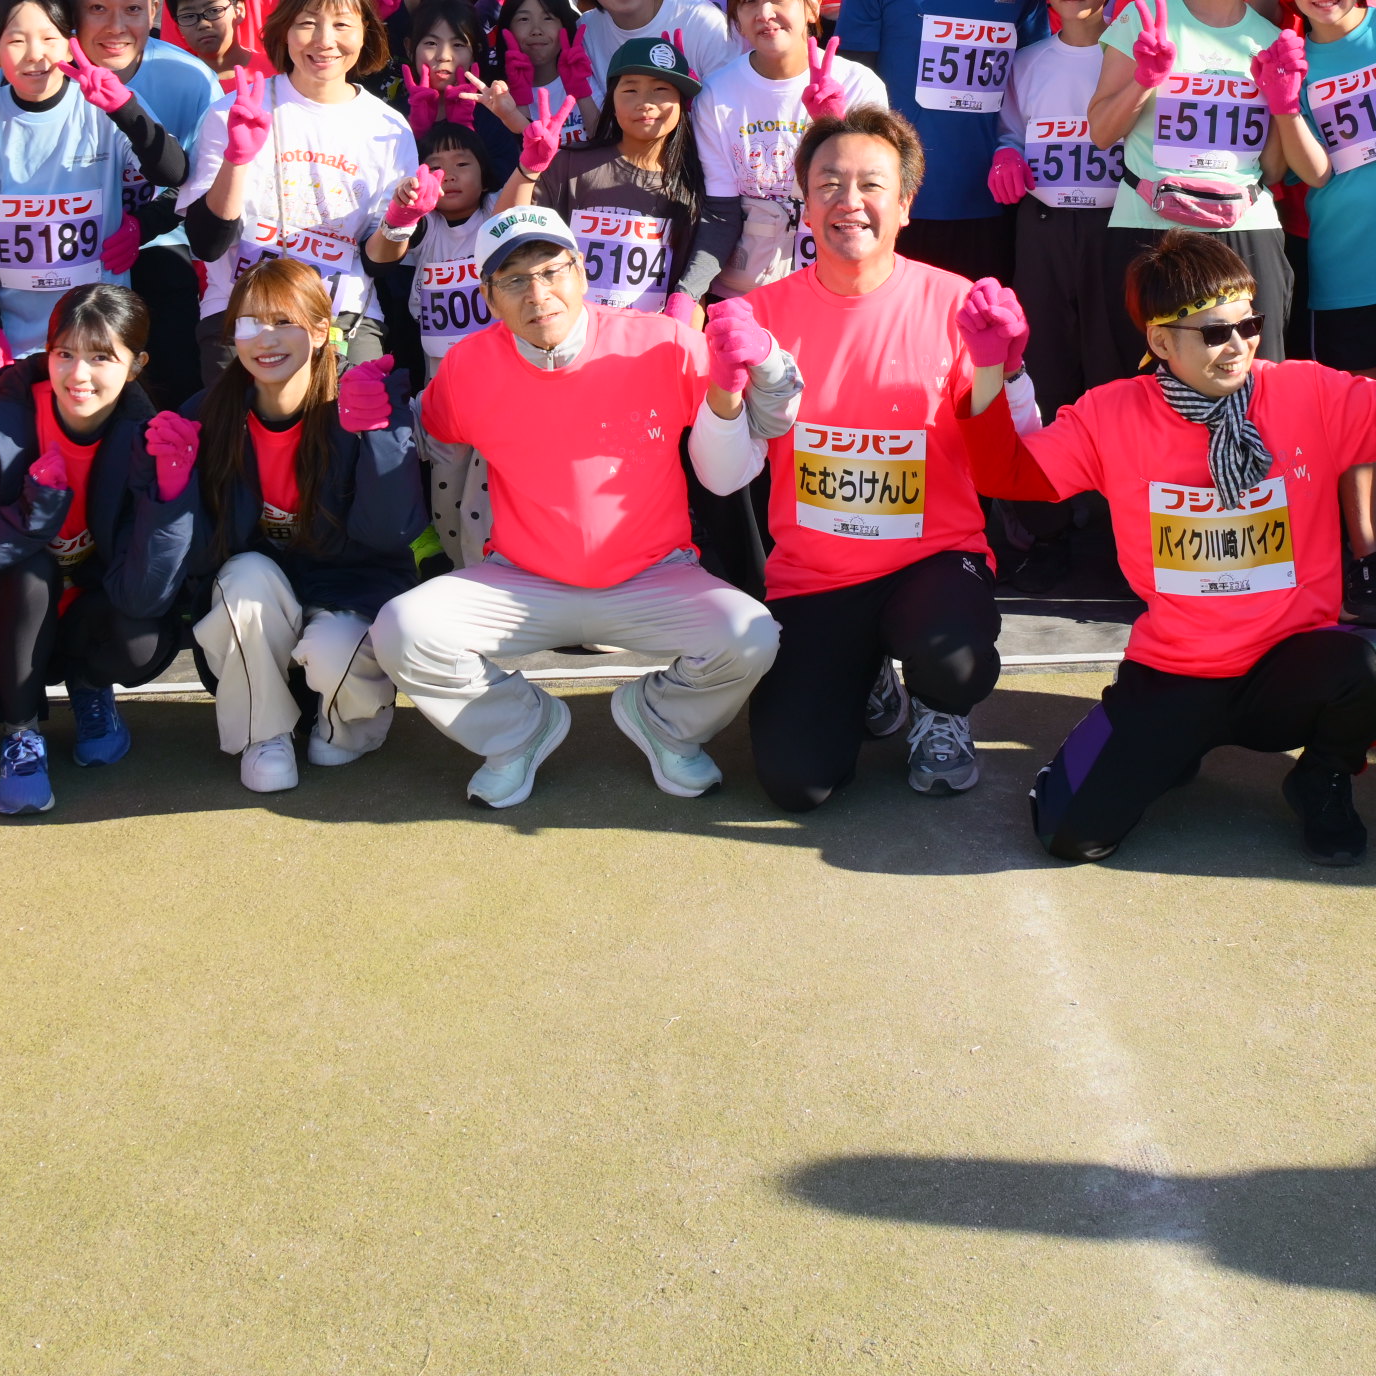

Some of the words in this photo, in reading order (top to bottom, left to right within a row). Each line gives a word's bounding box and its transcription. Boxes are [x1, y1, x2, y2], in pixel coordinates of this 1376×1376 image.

[933, 20, 1012, 44] フジパン
[920, 45, 1010, 88] E5153
[1168, 75, 1261, 100] フジパン
[1157, 101, 1266, 147] E5115
[1, 196, 93, 219] フジパン
[255, 222, 344, 262] フジパン
[580, 215, 666, 240] フジパン
[804, 426, 914, 456] フジパン
[798, 461, 921, 505] たむらけんじ
[1158, 519, 1286, 561] バイク川崎バイク
